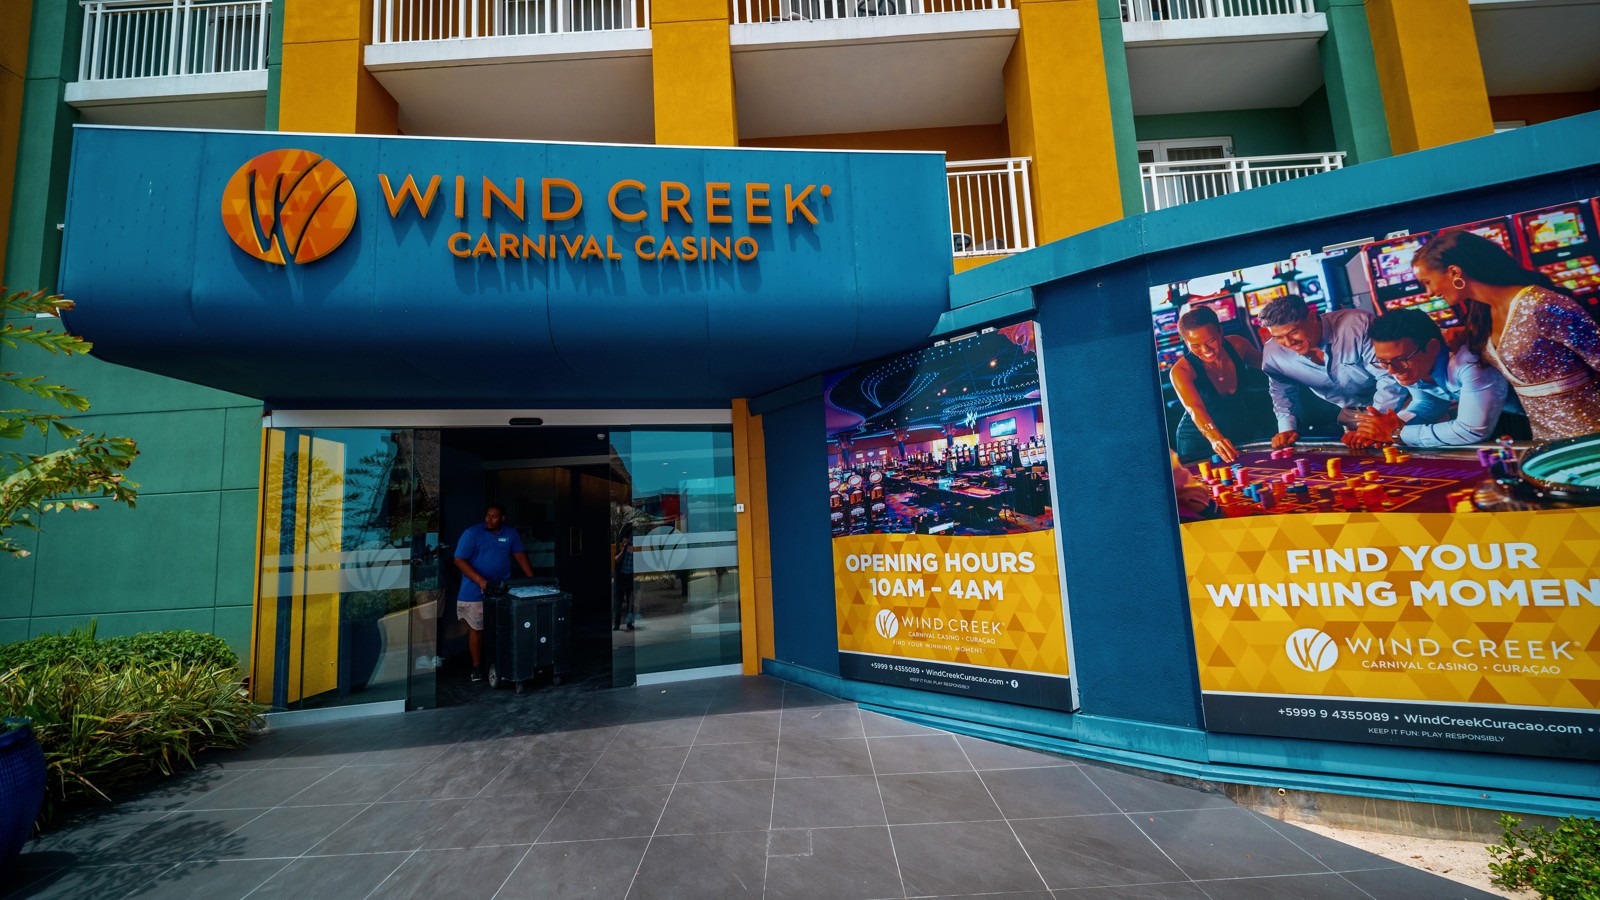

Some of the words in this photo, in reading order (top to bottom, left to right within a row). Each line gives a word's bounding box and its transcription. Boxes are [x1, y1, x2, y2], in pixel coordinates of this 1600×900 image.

[378, 173, 582, 221] WIND
[608, 179, 820, 224] CREEK
[447, 231, 622, 260] CARNIVAL
[634, 235, 759, 261] CASINO
[845, 553, 939, 572] OPENING
[945, 551, 1036, 573] HOURS
[1286, 547, 1389, 573] FIND
[1398, 542, 1541, 571] YOUR
[869, 577, 925, 597] 10AM
[948, 579, 1004, 600] 4AM
[1204, 581, 1398, 607] WINNING
[901, 615, 944, 631] WIND
[907, 631, 936, 639] CARNIVAL
[937, 633, 960, 641] CASINO
[965, 636, 996, 644] CURAÇAO
[1344, 637, 1440, 657] WIND
[870, 662, 888, 670] +5999
[894, 665, 920, 674] 4355089
[925, 669, 1004, 685] WindCreekCuracao.com
[1361, 660, 1423, 670] CARNIVAL
[1427, 662, 1478, 672] CASINO
[1492, 663, 1561, 676] CURAÇAO
[1278, 707, 1316, 718] +5999
[1319, 709, 1328, 718] 9
[1331, 710, 1390, 722] 4355089
[1403, 713, 1583, 734] WindCreekCuracao.com
[1445, 732, 1505, 742] RESPONSIBLY
